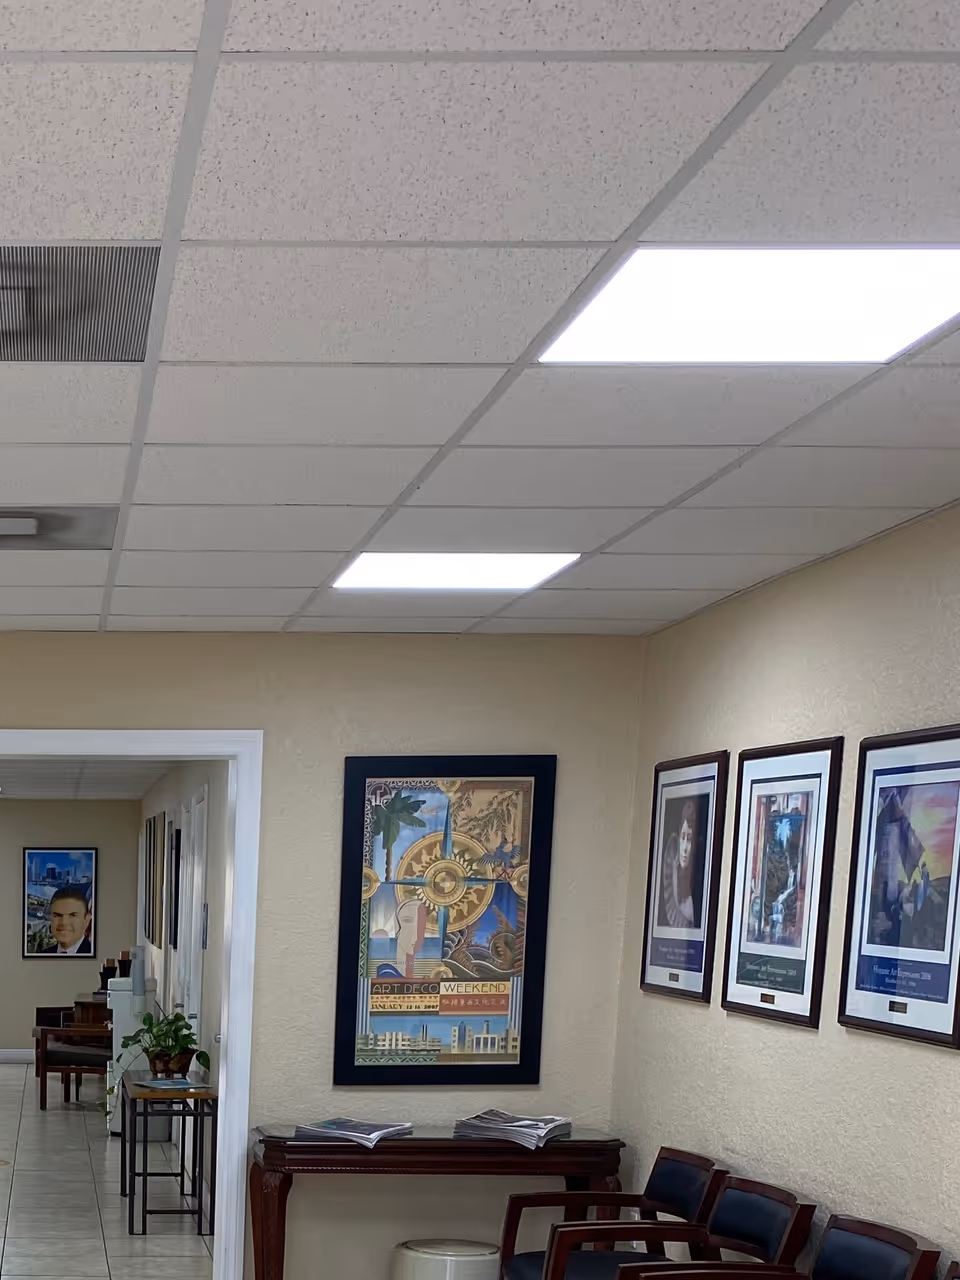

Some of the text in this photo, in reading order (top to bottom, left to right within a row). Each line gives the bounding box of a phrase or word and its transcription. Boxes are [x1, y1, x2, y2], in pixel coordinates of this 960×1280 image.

[372, 983, 507, 994] ART DECO WEEKEND
